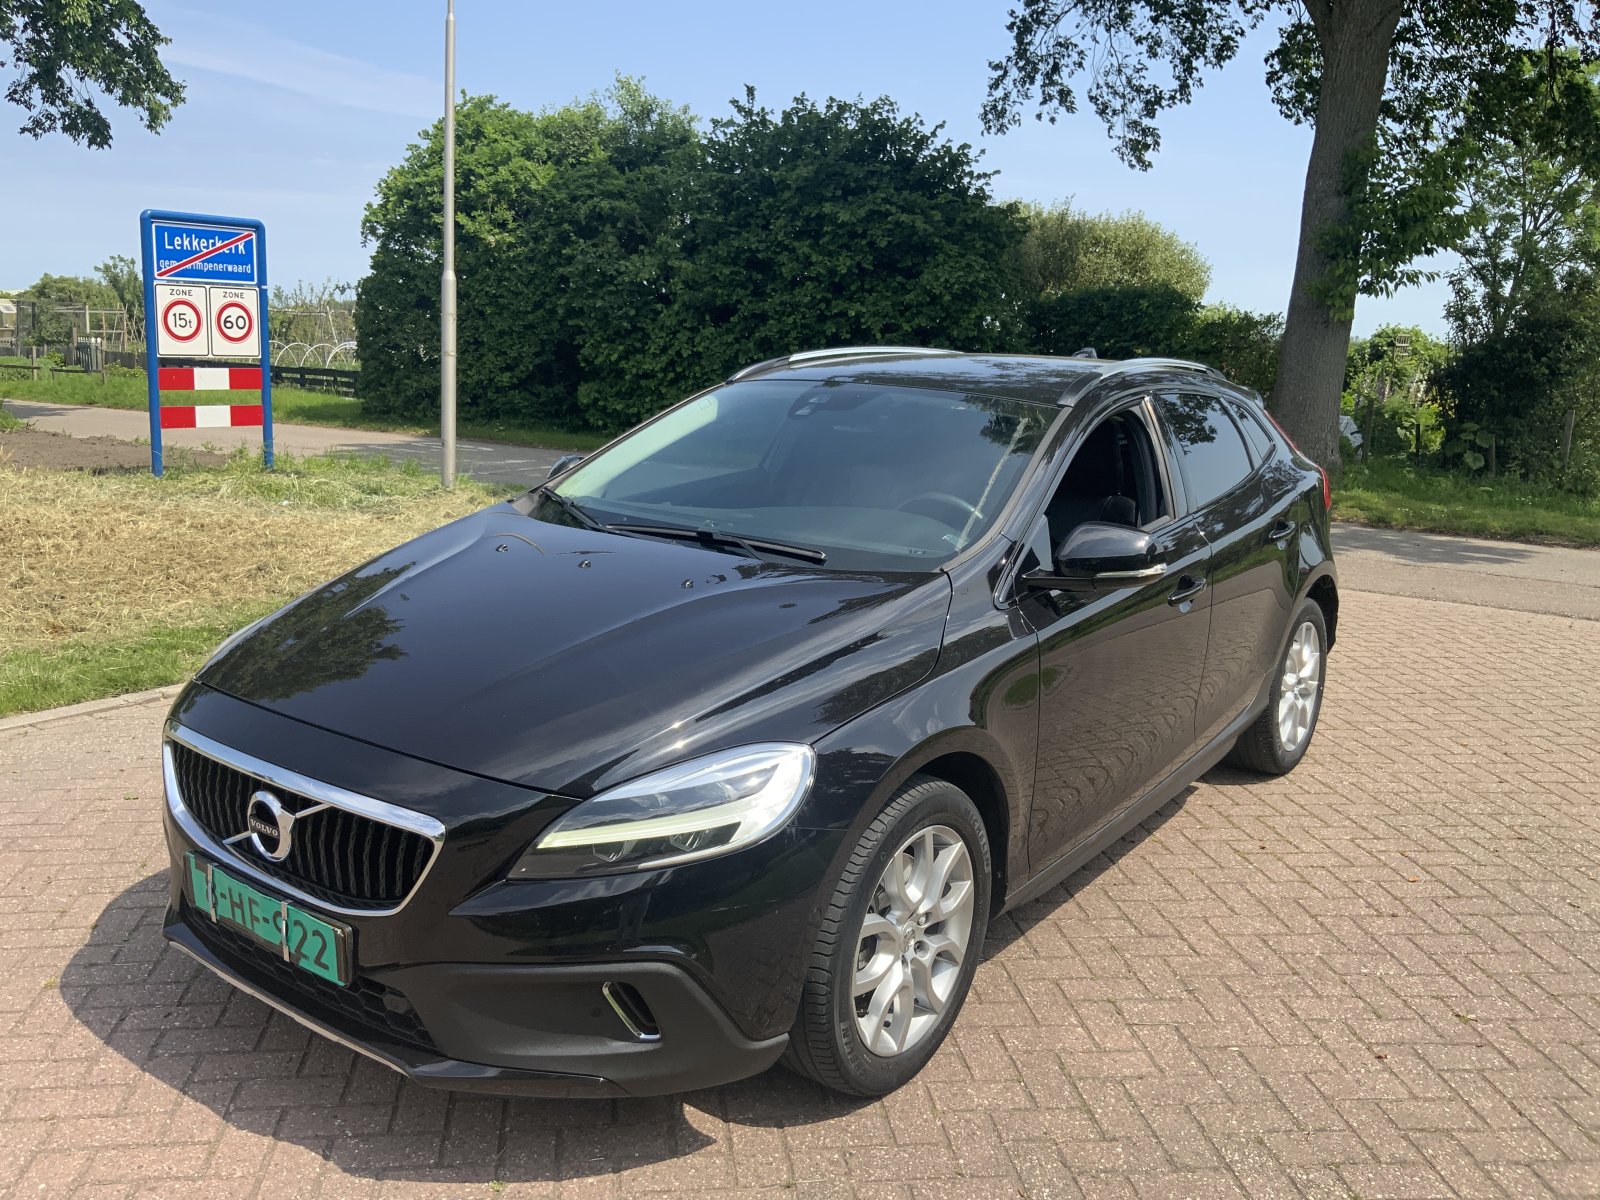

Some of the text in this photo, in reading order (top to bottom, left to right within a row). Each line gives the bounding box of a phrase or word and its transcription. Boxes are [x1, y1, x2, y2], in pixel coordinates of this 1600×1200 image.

[183, 259, 251, 274] rimpenerwaard
[169, 288, 193, 296] ZONE
[222, 291, 245, 299] ZONE
[172, 312, 193, 329] 15t
[223, 314, 247, 330] 60
[249, 818, 279, 837] VOLVO
